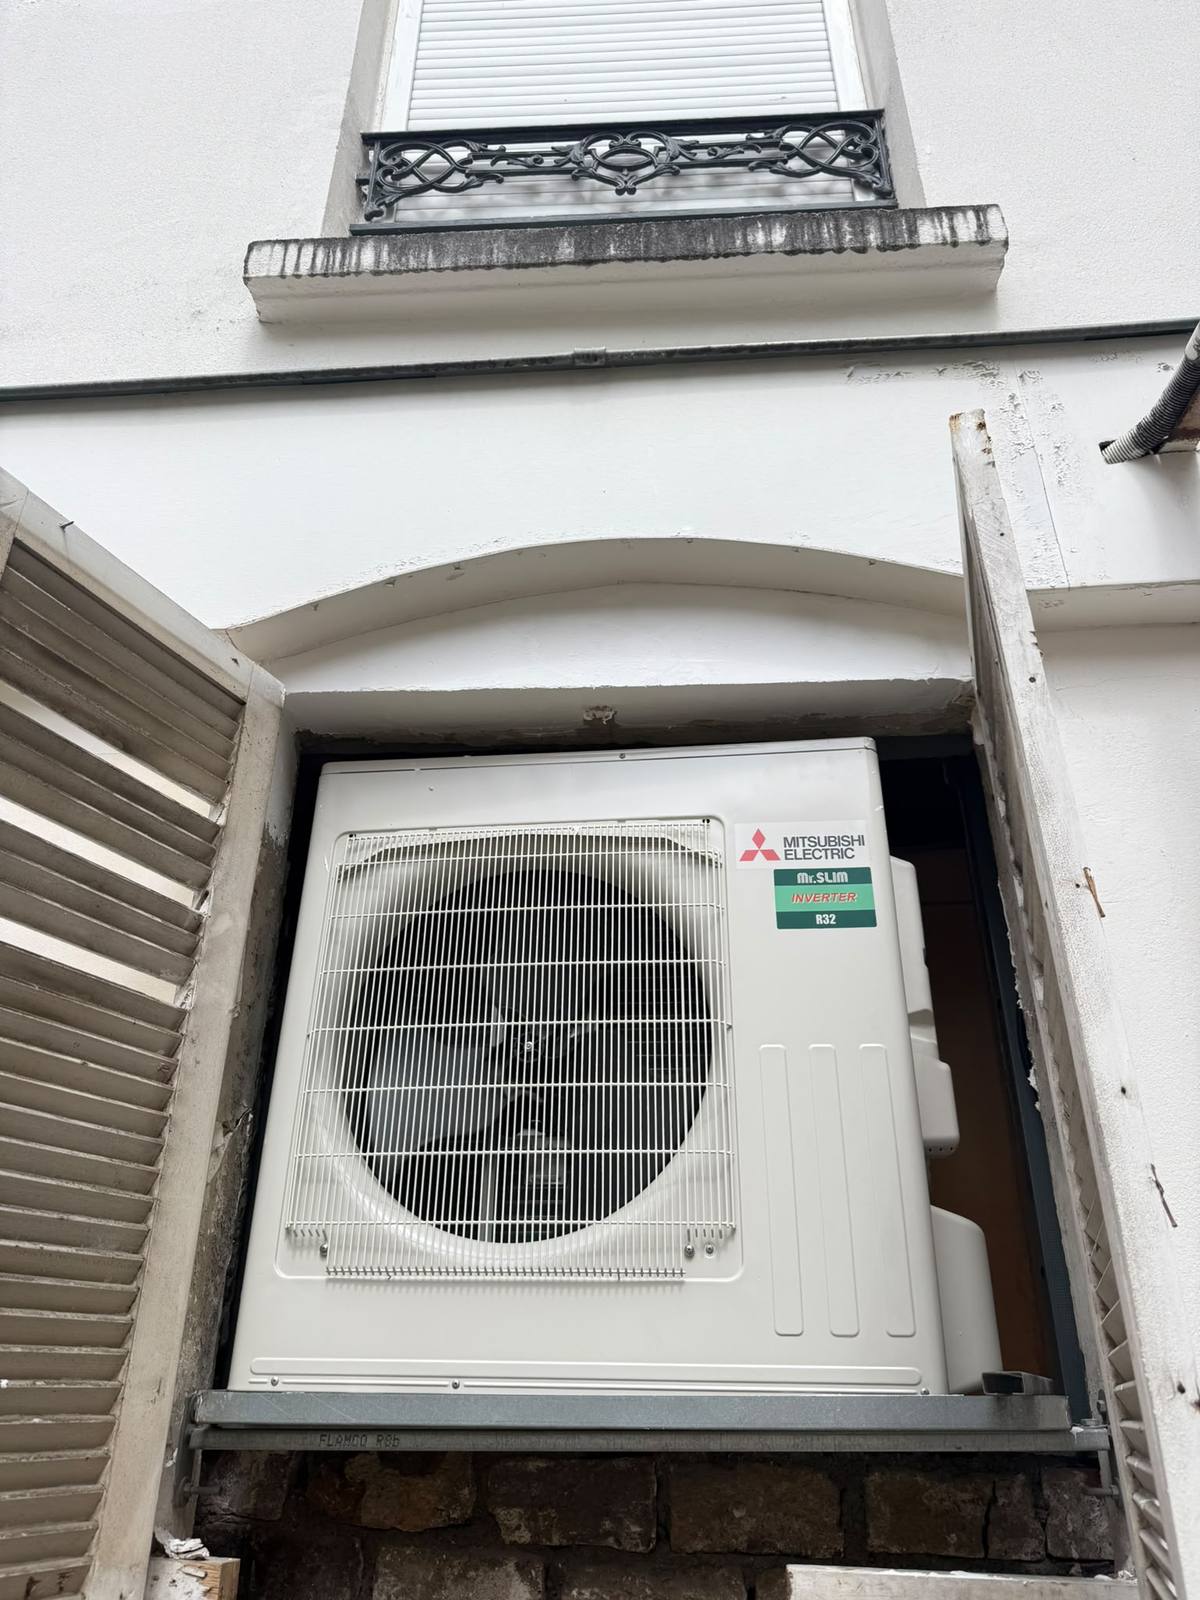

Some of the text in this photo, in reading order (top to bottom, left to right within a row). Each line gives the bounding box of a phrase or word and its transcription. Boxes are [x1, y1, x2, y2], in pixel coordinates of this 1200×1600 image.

[784, 835, 865, 848] MITSUBISHI
[784, 848, 855, 860] ELECTRIC
[792, 892, 857, 904] INVERTER
[816, 914, 836, 925] R32
